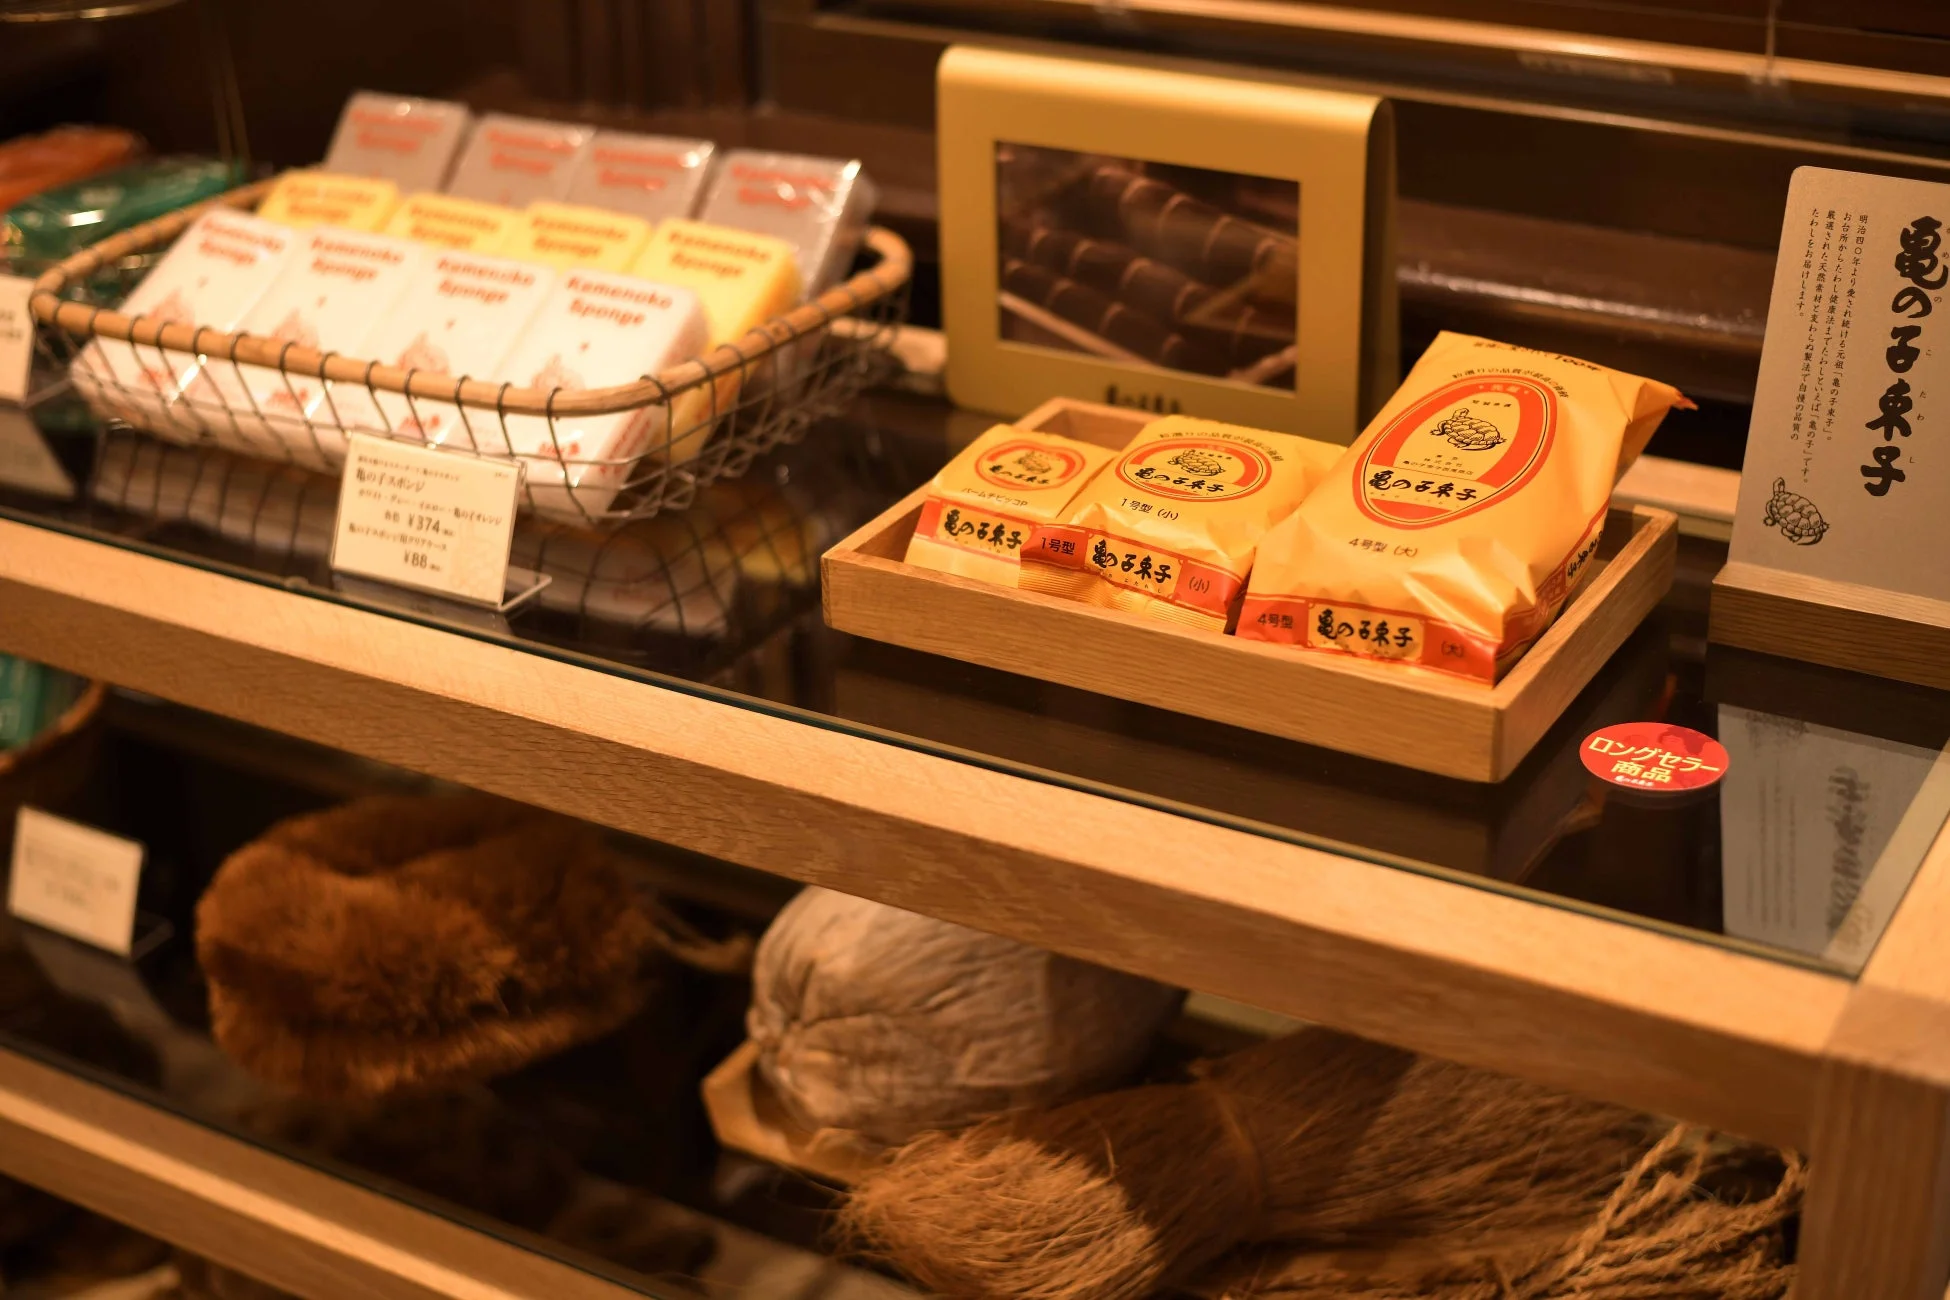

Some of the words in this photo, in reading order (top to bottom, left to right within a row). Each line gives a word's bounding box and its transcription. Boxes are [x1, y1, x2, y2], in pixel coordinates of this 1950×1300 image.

[311, 235, 404, 265] Kamenoko
[669, 230, 771, 262] Kamenoko
[311, 257, 378, 284] Sponge
[437, 257, 537, 287] Kamenoko
[671, 252, 744, 278] Sponge
[1796, 208, 1819, 317] たわしをお届けします。
[437, 278, 510, 305] Sponge
[567, 275, 673, 309] Kamenoko
[568, 298, 645, 326] Sponge
[1861, 215, 1949, 497] 亀の子束子
[356, 467, 426, 492] 亀の子スポンジ
[1134, 467, 1224, 492] 亀の子束子
[1368, 469, 1477, 501] 亀の子束子
[408, 512, 440, 534] ¥374
[944, 508, 1022, 550] 亀の子束子
[403, 549, 428, 569] ¥88
[1040, 536, 1076, 556] 1号型
[1348, 538, 1388, 553] 4号型
[1092, 539, 1172, 584] 亀の子束子
[1257, 613, 1294, 630] 4号型
[1317, 608, 1413, 648] 亀の子束子
[1588, 736, 1720, 772] ロングセラー
[1611, 760, 1672, 783] 商品
